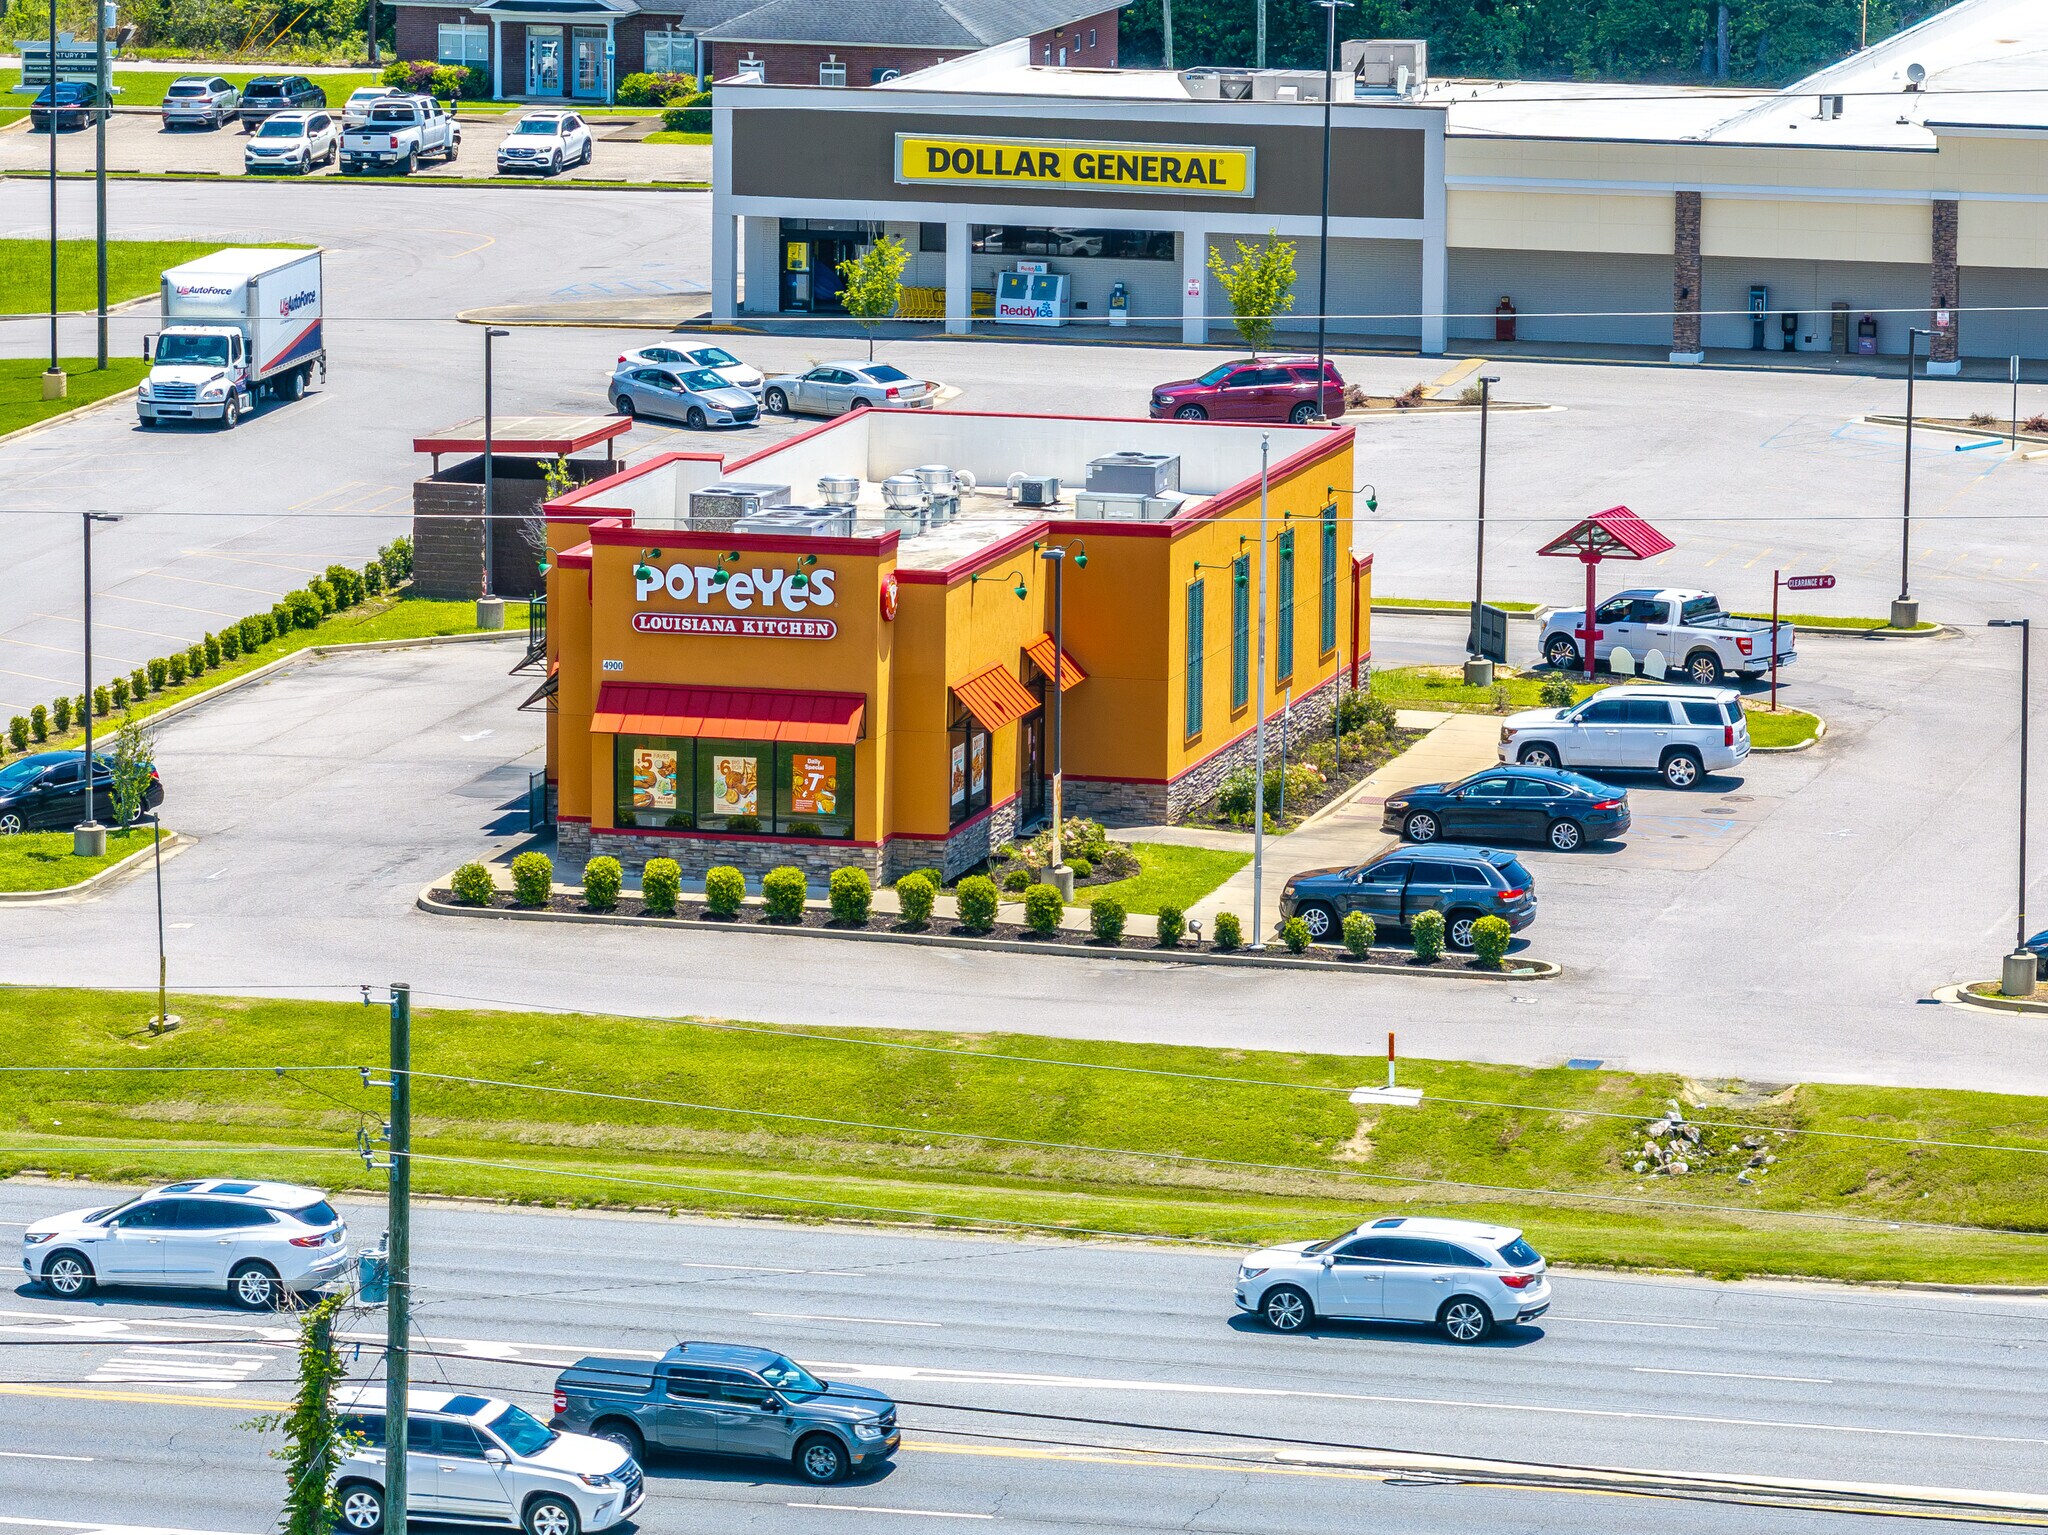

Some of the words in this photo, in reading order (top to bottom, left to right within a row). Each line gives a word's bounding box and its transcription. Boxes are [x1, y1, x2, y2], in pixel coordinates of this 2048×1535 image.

[926, 147, 1060, 177] DOLLAR
[1073, 152, 1226, 185] GENERAL
[1788, 578, 1818, 588] CLEARANCE
[639, 616, 737, 632] LOUISIANA
[742, 619, 829, 636] KITCHEN
[603, 660, 623, 670] 4900
[807, 758, 821, 766] Daily
